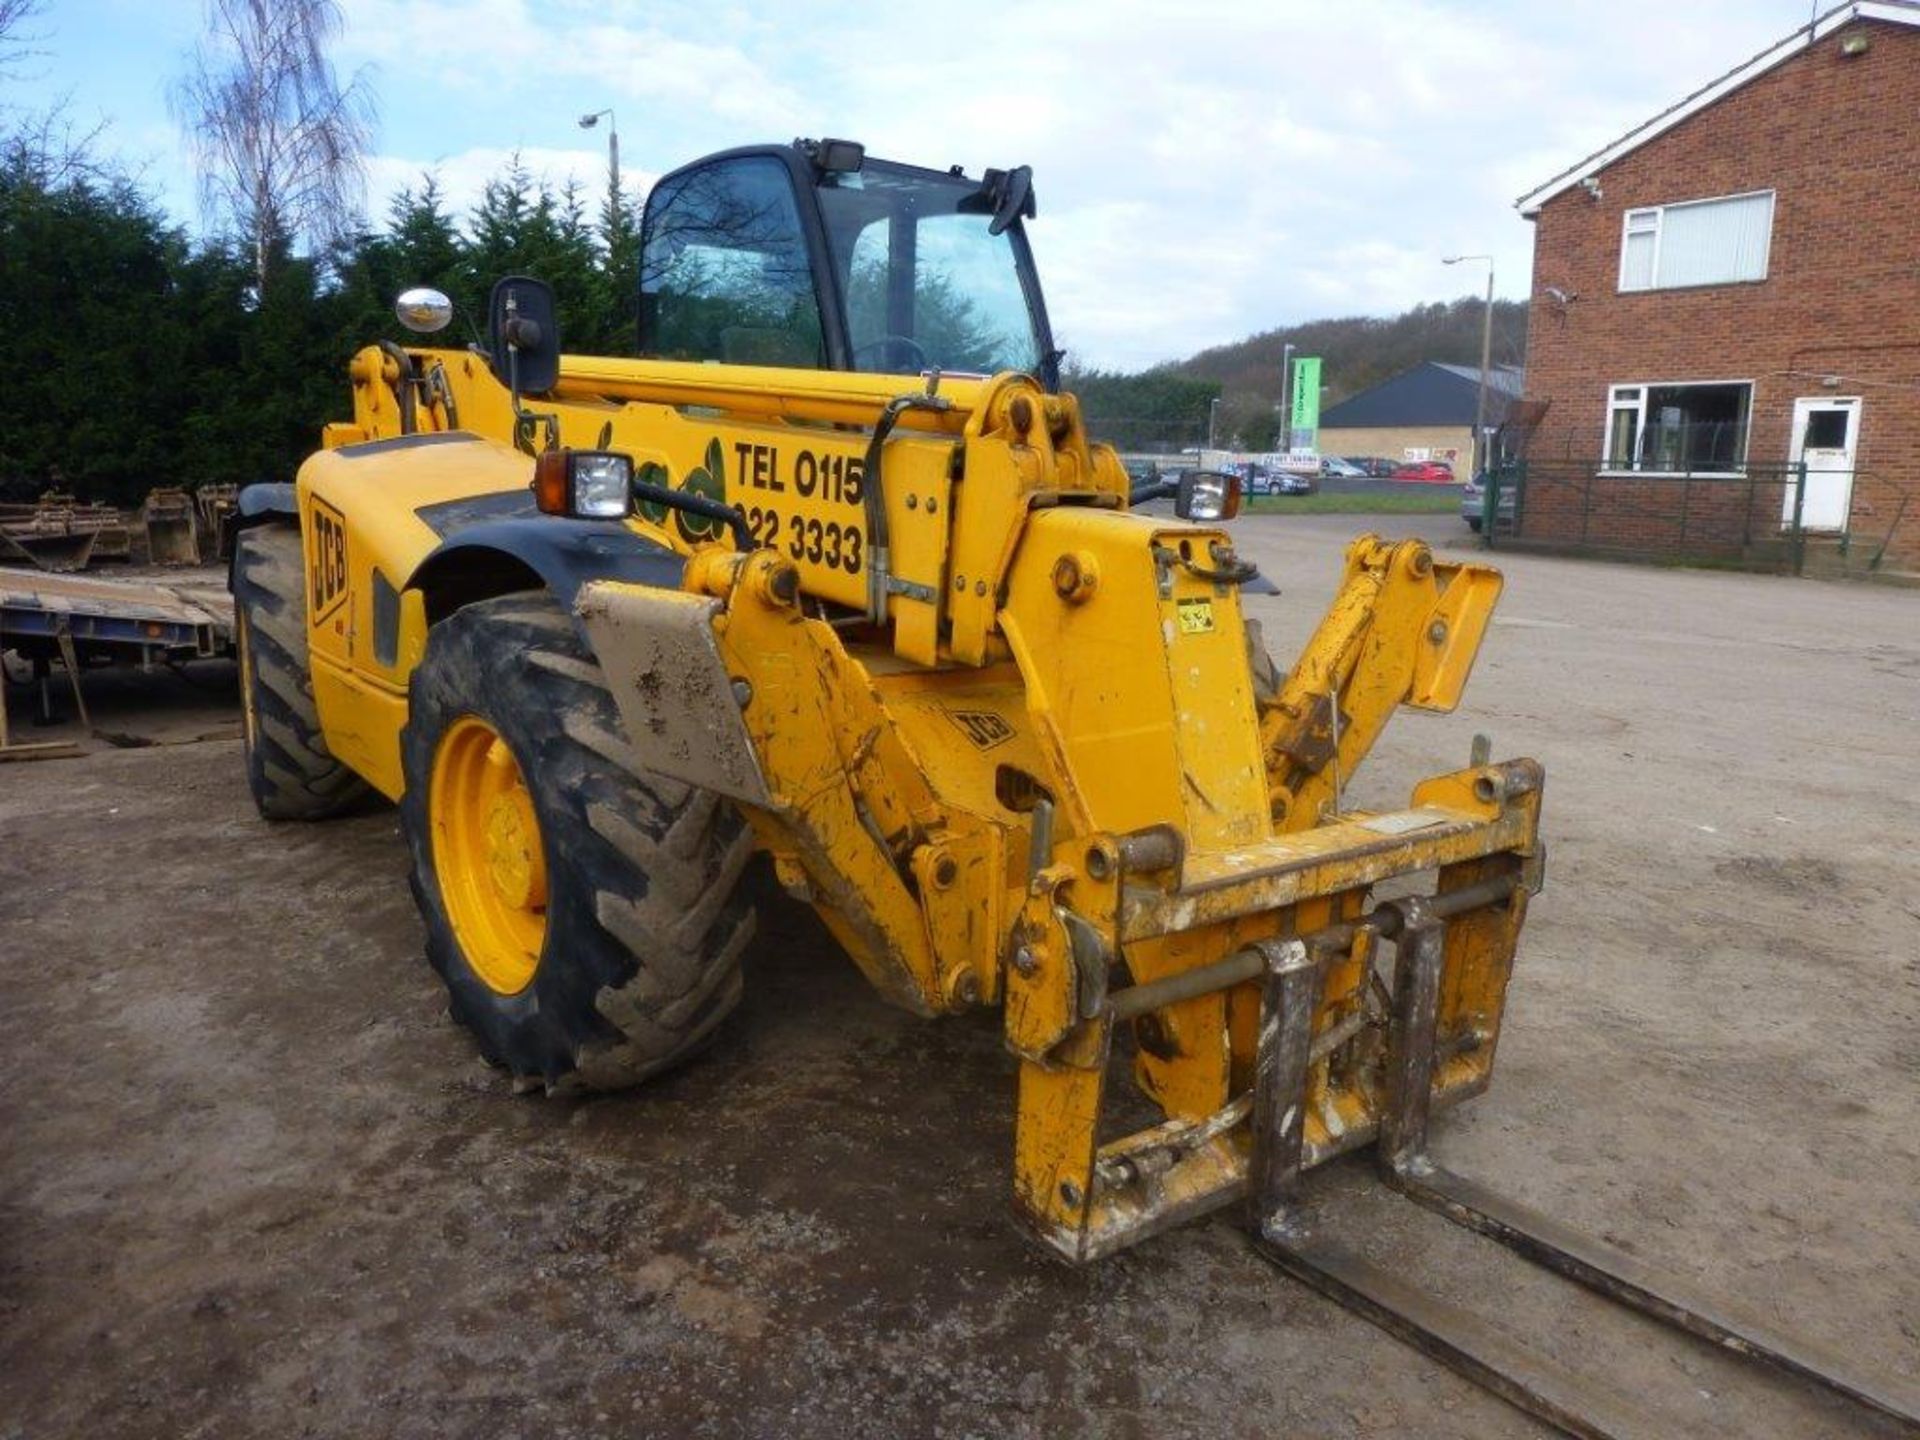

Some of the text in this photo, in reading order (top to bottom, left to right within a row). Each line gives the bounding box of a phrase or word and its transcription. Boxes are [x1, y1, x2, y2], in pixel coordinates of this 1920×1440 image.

[735, 442, 864, 505] TEL 0115
[314, 509, 346, 611] JCB
[734, 502, 862, 575] 22 3333
[954, 714, 1010, 746] JCB
